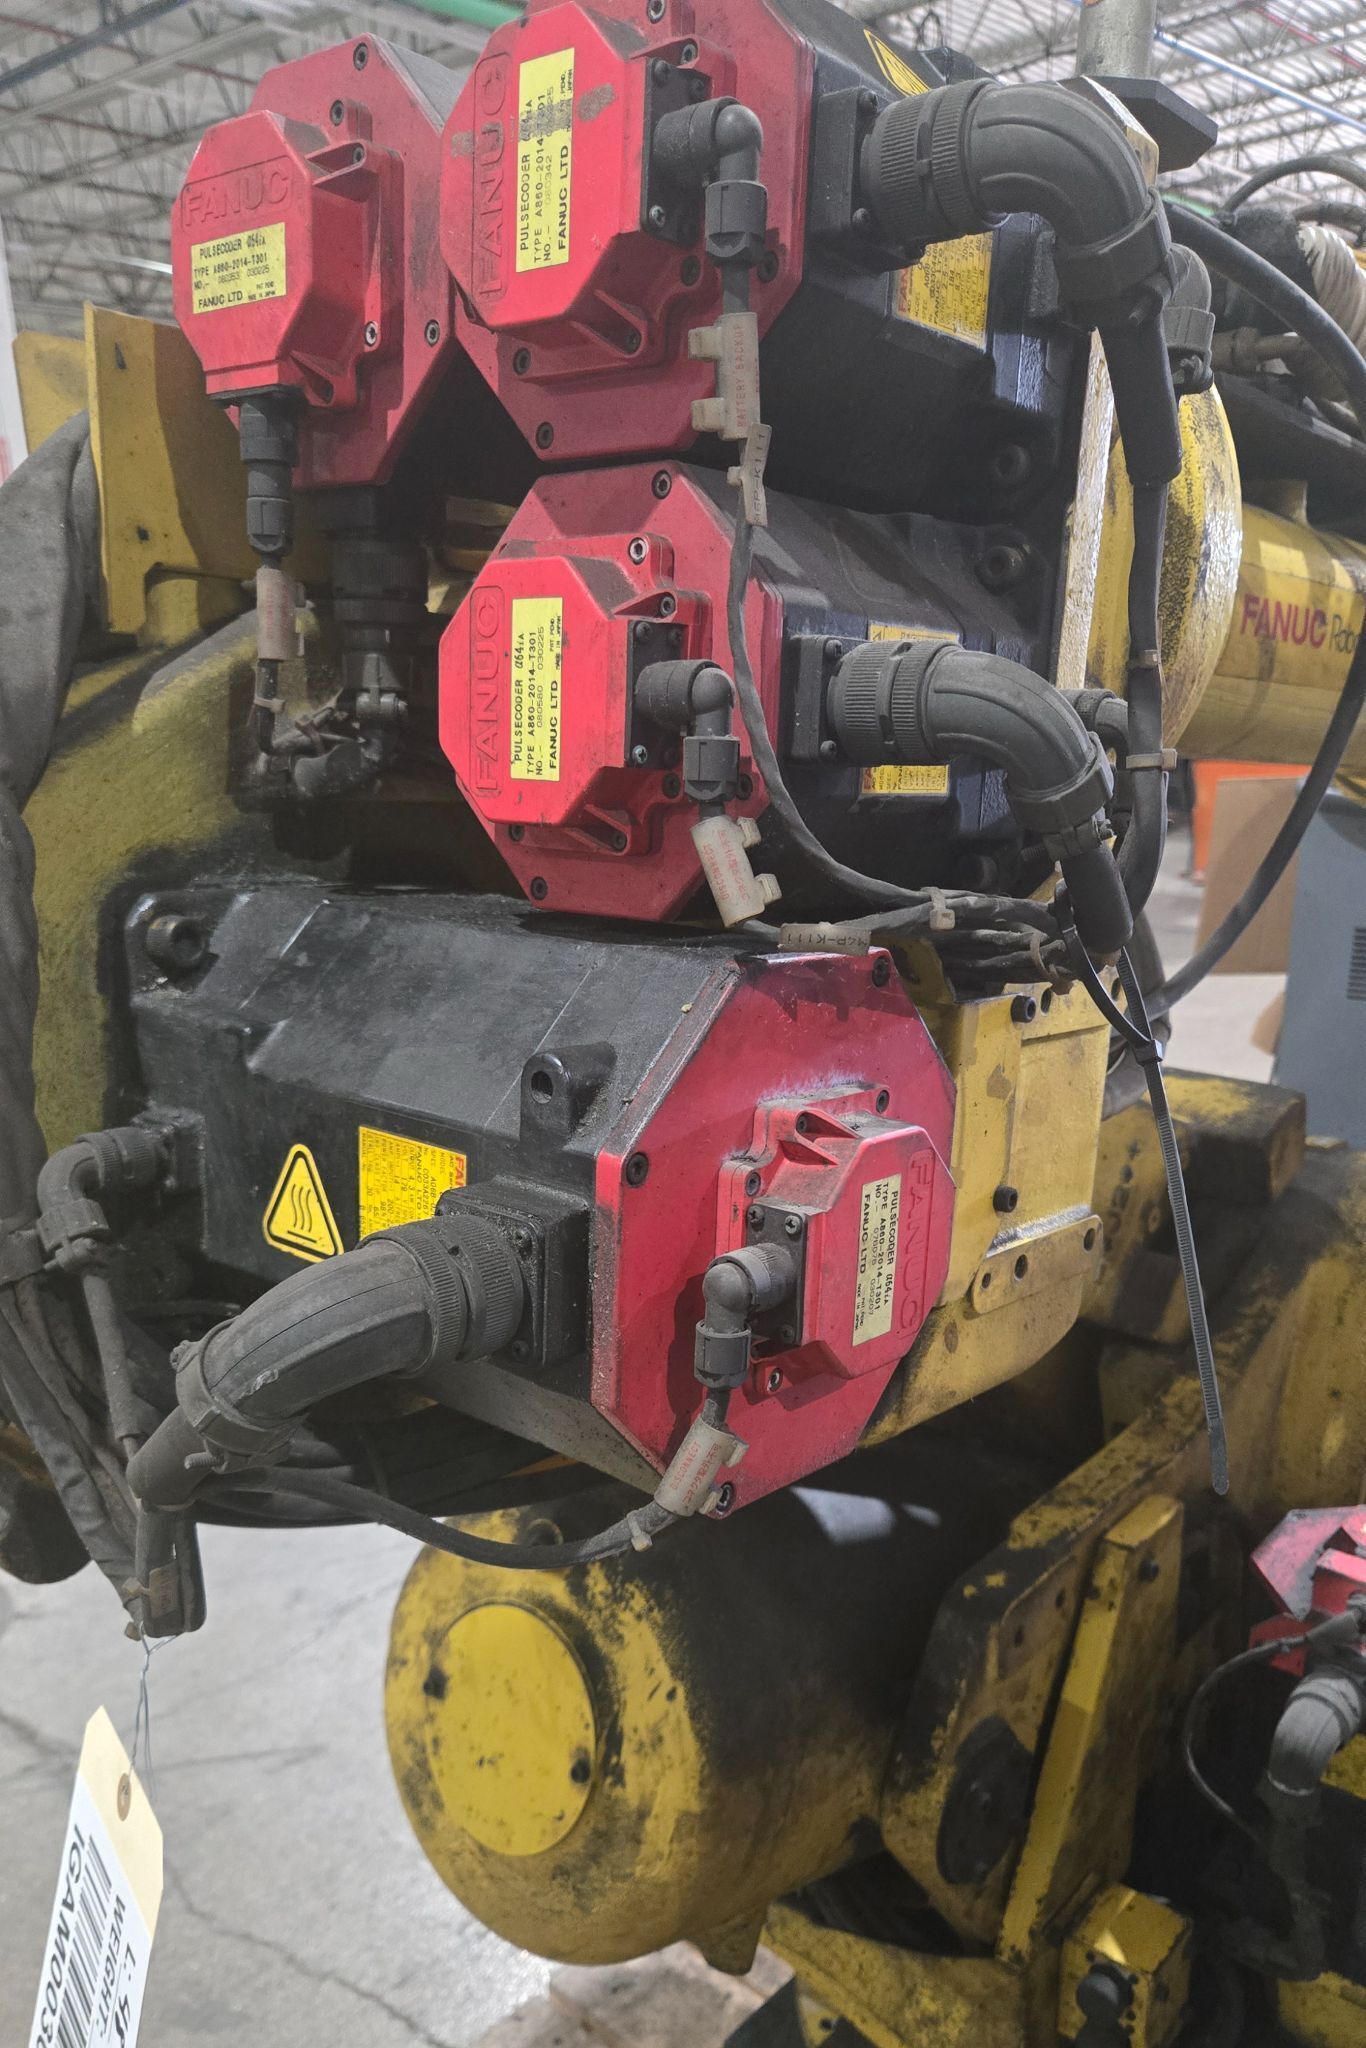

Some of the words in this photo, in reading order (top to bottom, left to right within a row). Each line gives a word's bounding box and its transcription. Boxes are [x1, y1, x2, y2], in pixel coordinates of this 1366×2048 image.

[480, 68, 504, 295] FANUC
[560, 145, 569, 179] LTD
[184, 171, 289, 228] FANUC
[520, 154, 530, 250] PULSECODER
[558, 187, 567, 250] FANUC
[194, 267, 209, 277] TYPE
[200, 238, 242, 259] PULSECODER
[534, 228, 542, 263] TYPE
[198, 293, 225, 309] FANUC
[228, 290, 243, 303] LTD
[735, 323, 744, 370] BACKUP
[735, 378, 746, 428] BATTERY
[1240, 592, 1327, 649] FANUC
[476, 600, 498, 790] FANUC
[528, 632, 537, 736] A860-2014-T301
[514, 680, 523, 761] PULSECODER
[549, 716, 558, 769] FANUC
[527, 745, 535, 774] TYPE
[861, 1194, 870, 1242] FANUC
[880, 1182, 889, 1210] TYPE
[887, 1191, 898, 1265] PULSECODER
[901, 1160, 930, 1329] FANUC
[875, 1218, 886, 1310] A860-2014-T301
[670, 1440, 701, 1490] DISCONNECT
[96, 1894, 126, 2038] WEIGHT:
